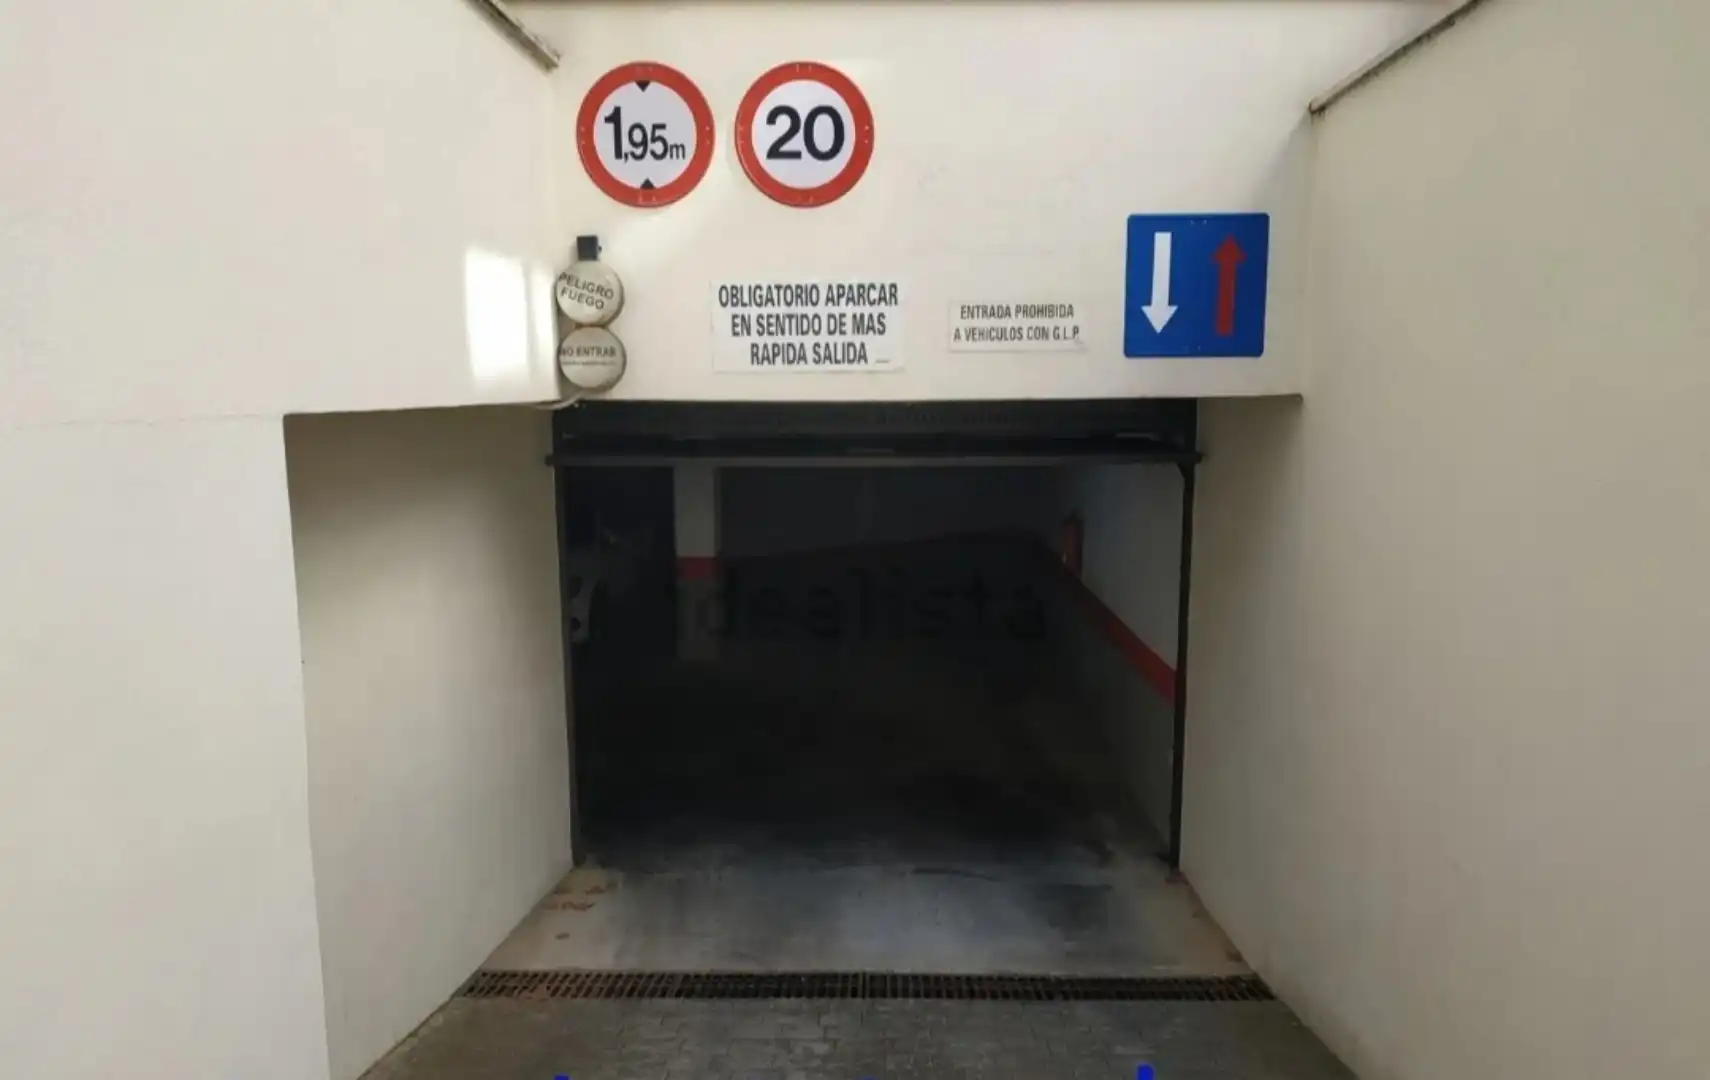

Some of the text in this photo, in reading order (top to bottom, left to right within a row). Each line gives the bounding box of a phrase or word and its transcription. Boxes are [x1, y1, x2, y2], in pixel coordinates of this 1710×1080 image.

[604, 105, 685, 163] 1,95m
[766, 105, 845, 161] 20
[558, 272, 614, 299] PELIGRO
[718, 282, 899, 308] OBLIGATORIO APARCAR
[561, 289, 604, 310] FUEGO
[960, 303, 1075, 320] ENTRADA PROHIBIDA
[731, 311, 887, 337] EN SENTIDO DE MAS
[953, 327, 960, 342] A
[965, 325, 1023, 342] VEHICULOS
[1027, 325, 1049, 341] CON
[560, 346, 616, 357] NO ENTRAR
[750, 341, 868, 366] RAPIDA SALIDA
